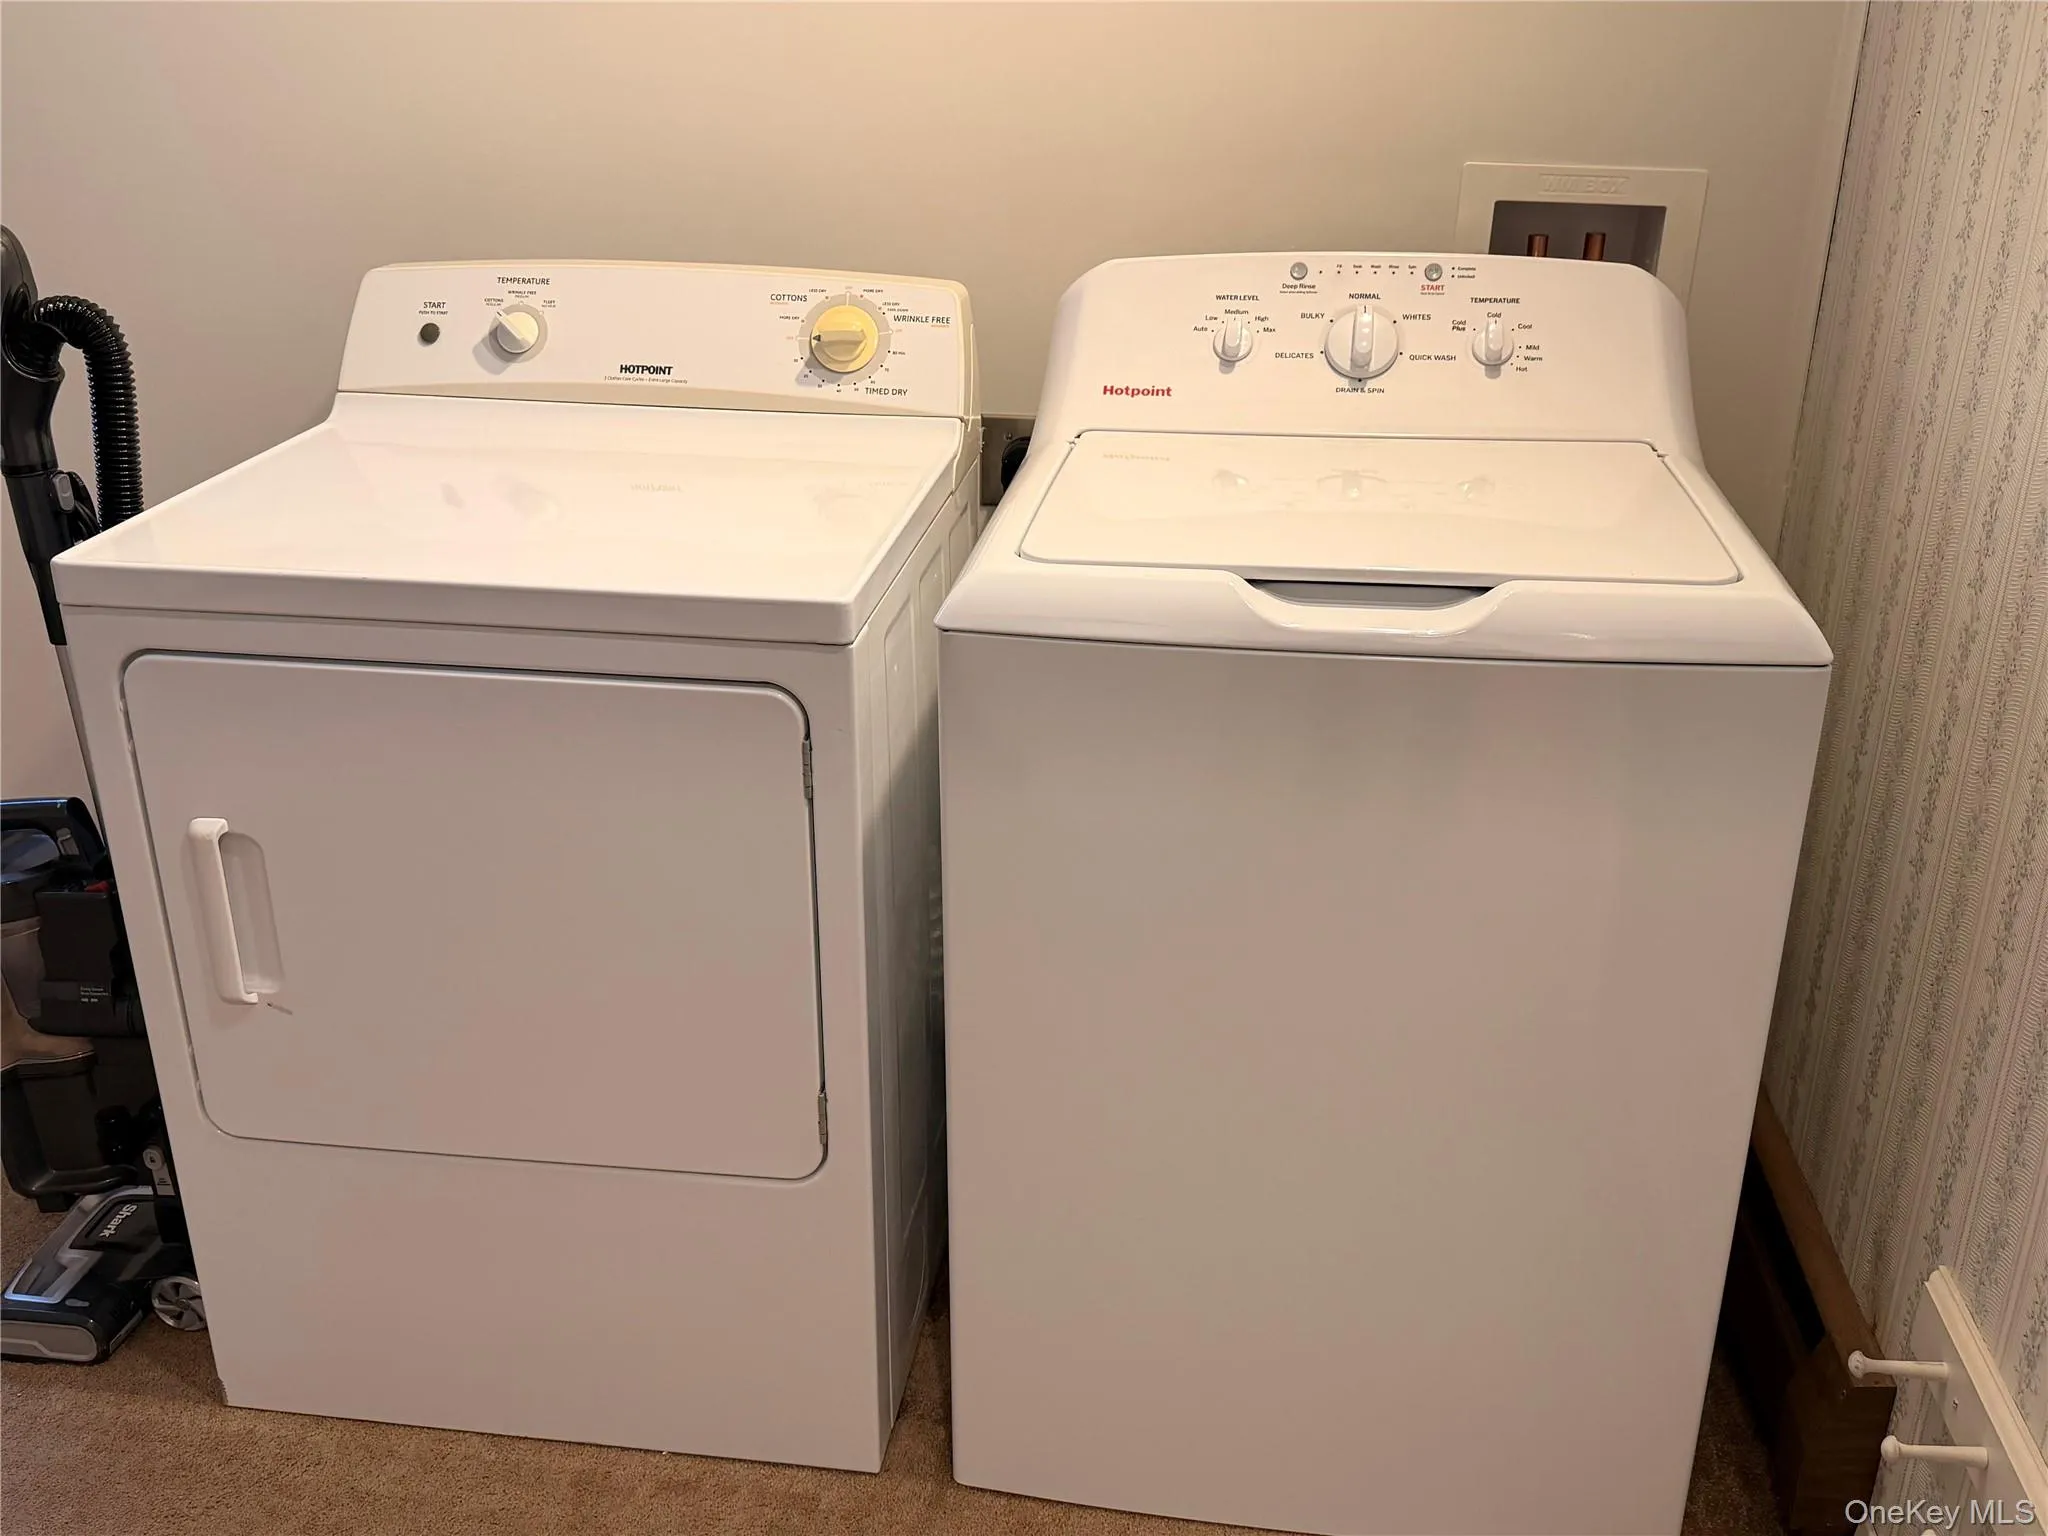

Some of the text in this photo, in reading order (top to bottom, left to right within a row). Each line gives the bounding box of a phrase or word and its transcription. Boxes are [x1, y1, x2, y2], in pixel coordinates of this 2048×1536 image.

[496, 276, 551, 286] TEMPERATURE
[770, 293, 808, 302] COTTONS
[894, 314, 951, 324] WRINKLE FREE
[620, 364, 674, 376] HOTPOINT
[865, 387, 908, 396] TIMED DRY
[1102, 384, 1172, 398] Hotpoint
[100, 1203, 138, 1238] Shark
